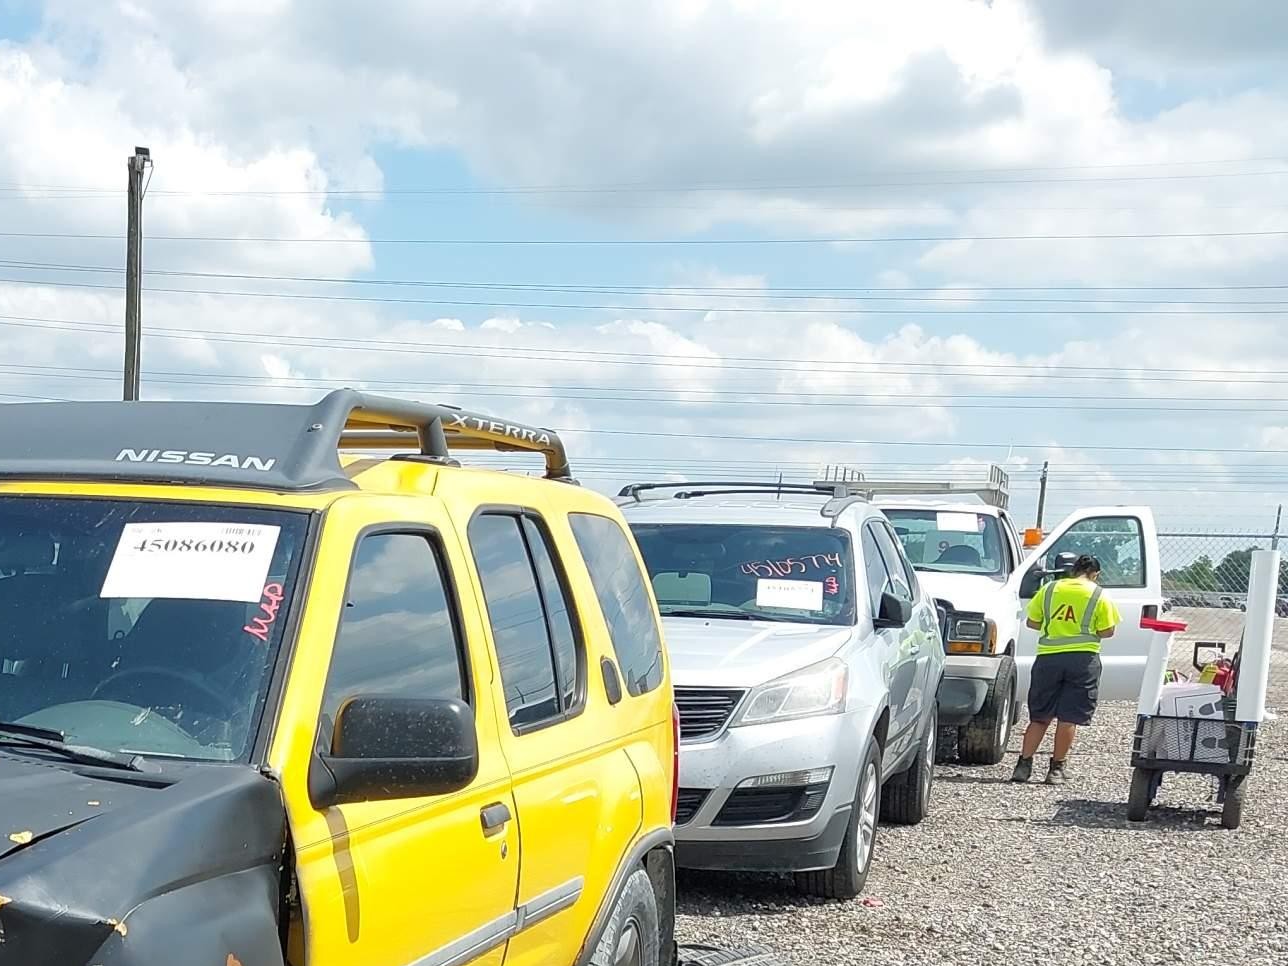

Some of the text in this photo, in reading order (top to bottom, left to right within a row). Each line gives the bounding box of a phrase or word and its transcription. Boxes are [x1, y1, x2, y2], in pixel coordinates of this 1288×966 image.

[450, 413, 550, 446] XTERRA
[115, 449, 276, 471] NISSAN
[133, 538, 255, 555] 45086080
